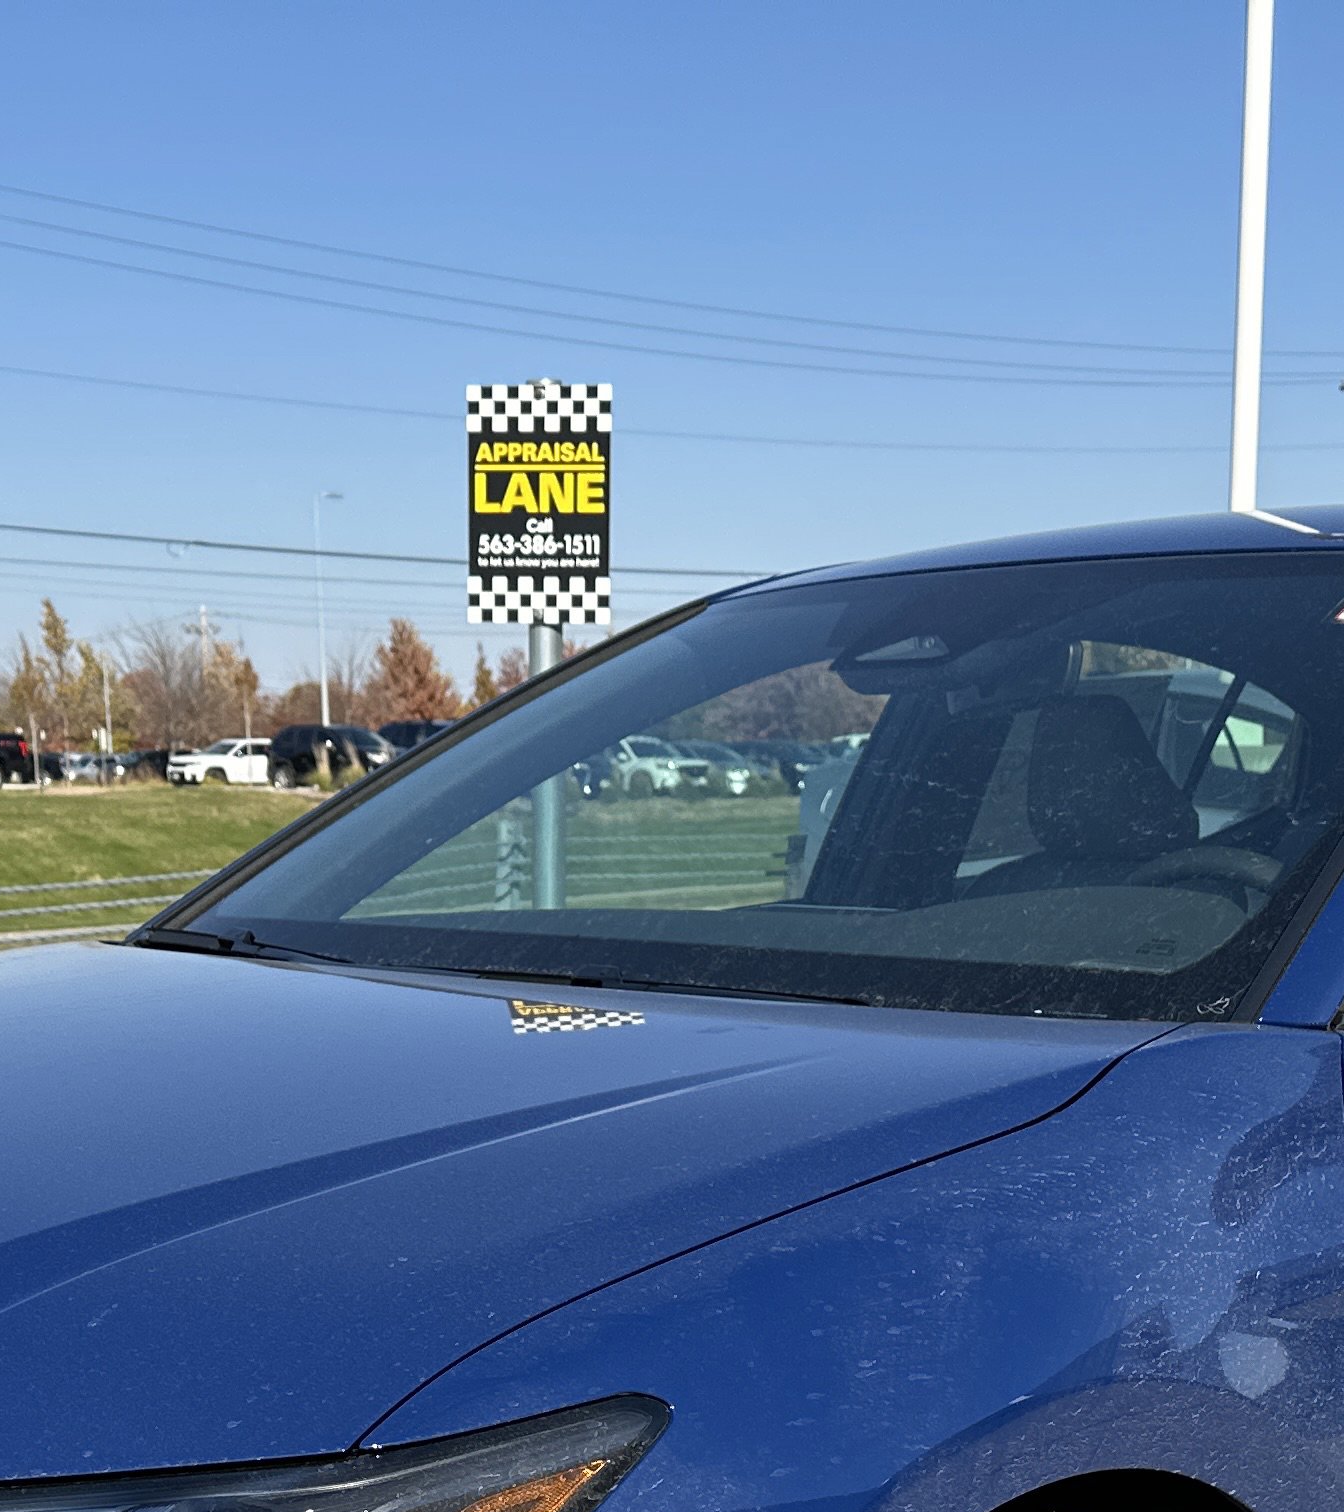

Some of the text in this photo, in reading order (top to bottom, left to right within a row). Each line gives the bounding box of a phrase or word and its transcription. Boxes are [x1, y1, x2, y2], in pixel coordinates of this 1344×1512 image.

[475, 441, 605, 462] APPRAISAL
[474, 472, 605, 514] LANE
[525, 517, 554, 533] Call
[478, 534, 600, 555] 563-386-1511
